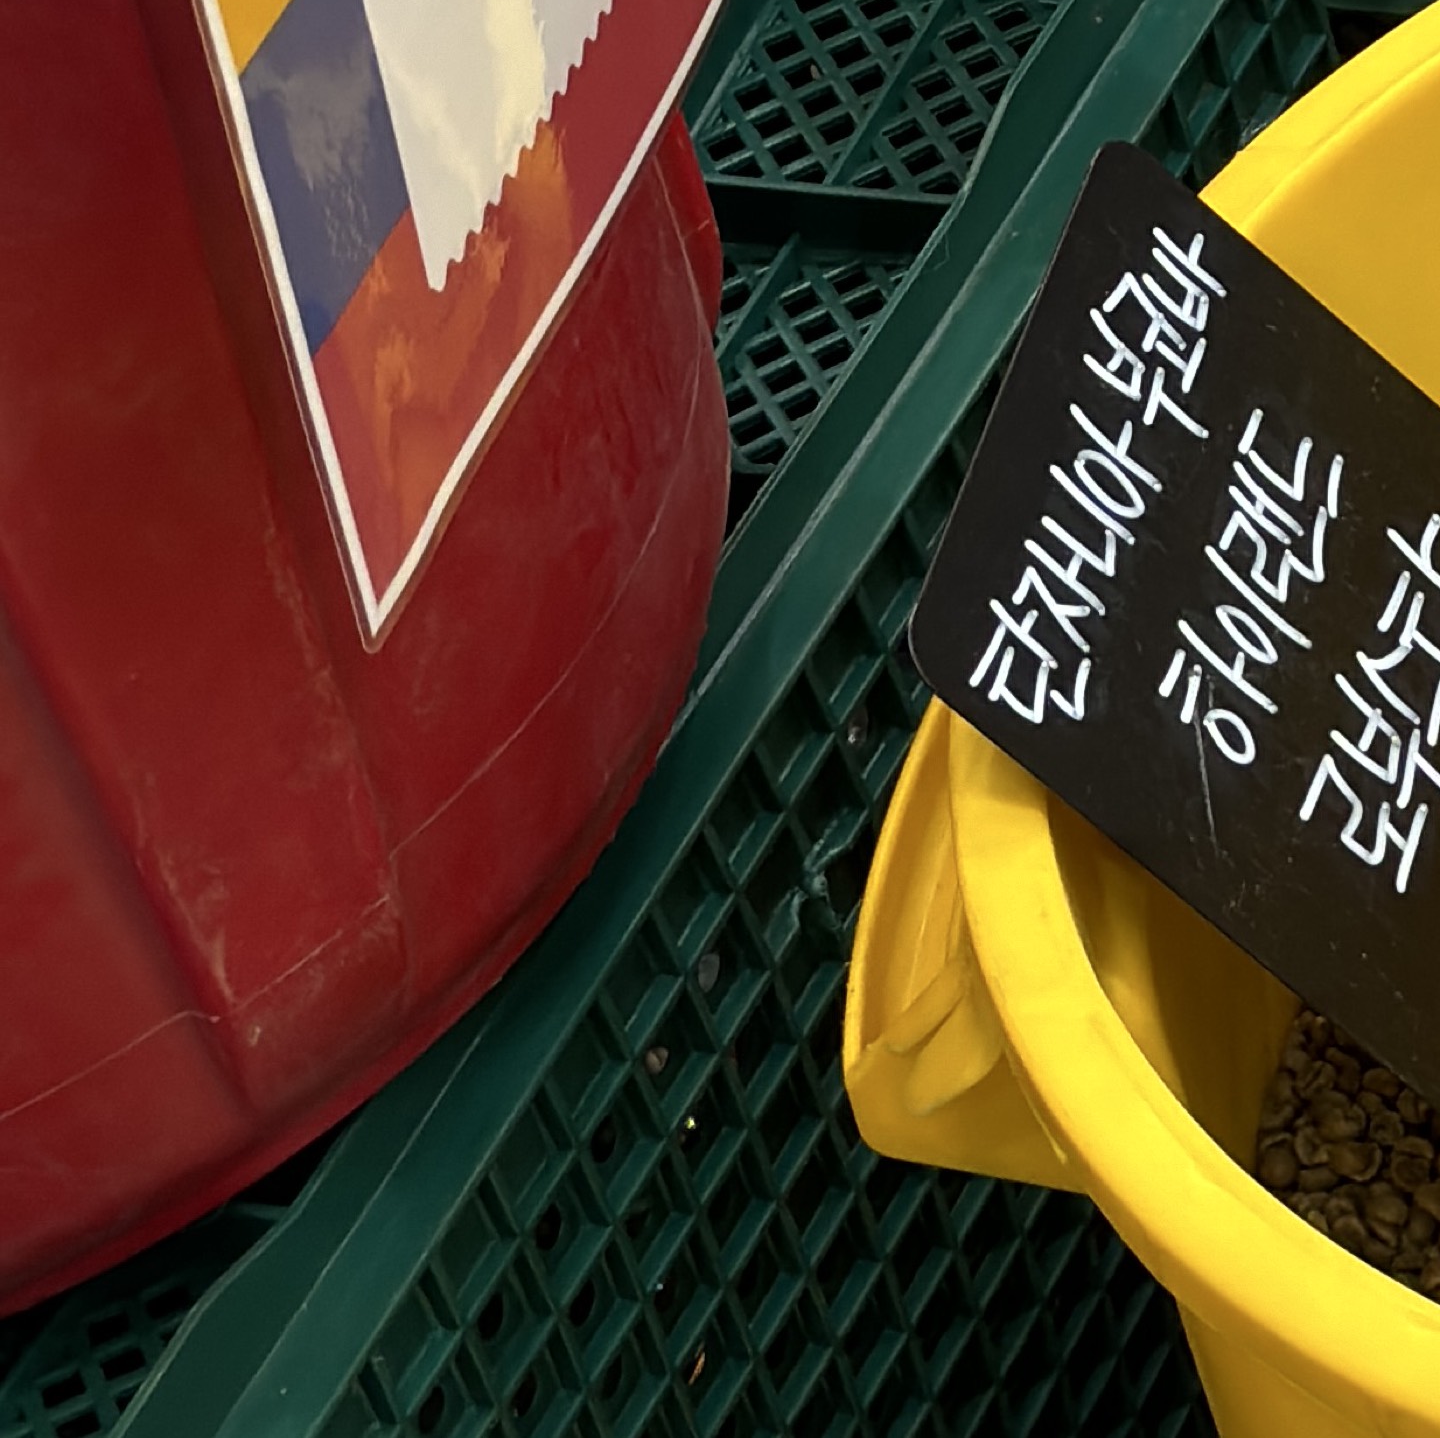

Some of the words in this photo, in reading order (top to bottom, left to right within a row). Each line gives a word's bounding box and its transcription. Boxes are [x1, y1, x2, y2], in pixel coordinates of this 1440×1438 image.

[969, 403, 1162, 725] 탄자니아
[1085, 227, 1227, 438] 부코바
[1158, 408, 1343, 767] 하이랜드
